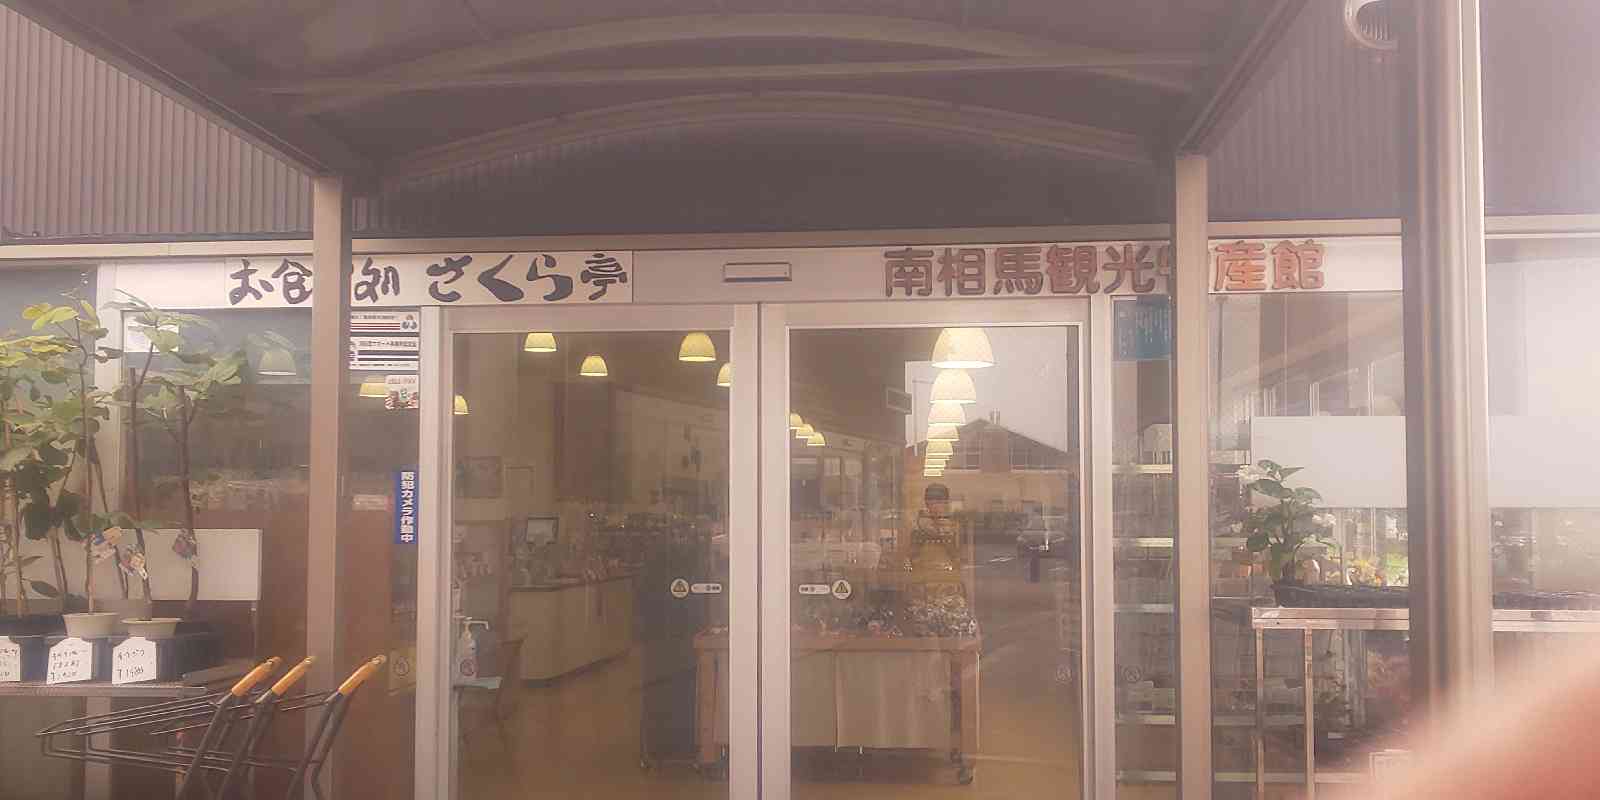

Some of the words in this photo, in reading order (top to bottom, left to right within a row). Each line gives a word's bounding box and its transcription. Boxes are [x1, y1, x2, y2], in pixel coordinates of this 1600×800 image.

[229, 256, 400, 305] お食処
[427, 253, 628, 303] さくら亭
[400, 471, 415, 543] 防犯カメラ作動中
